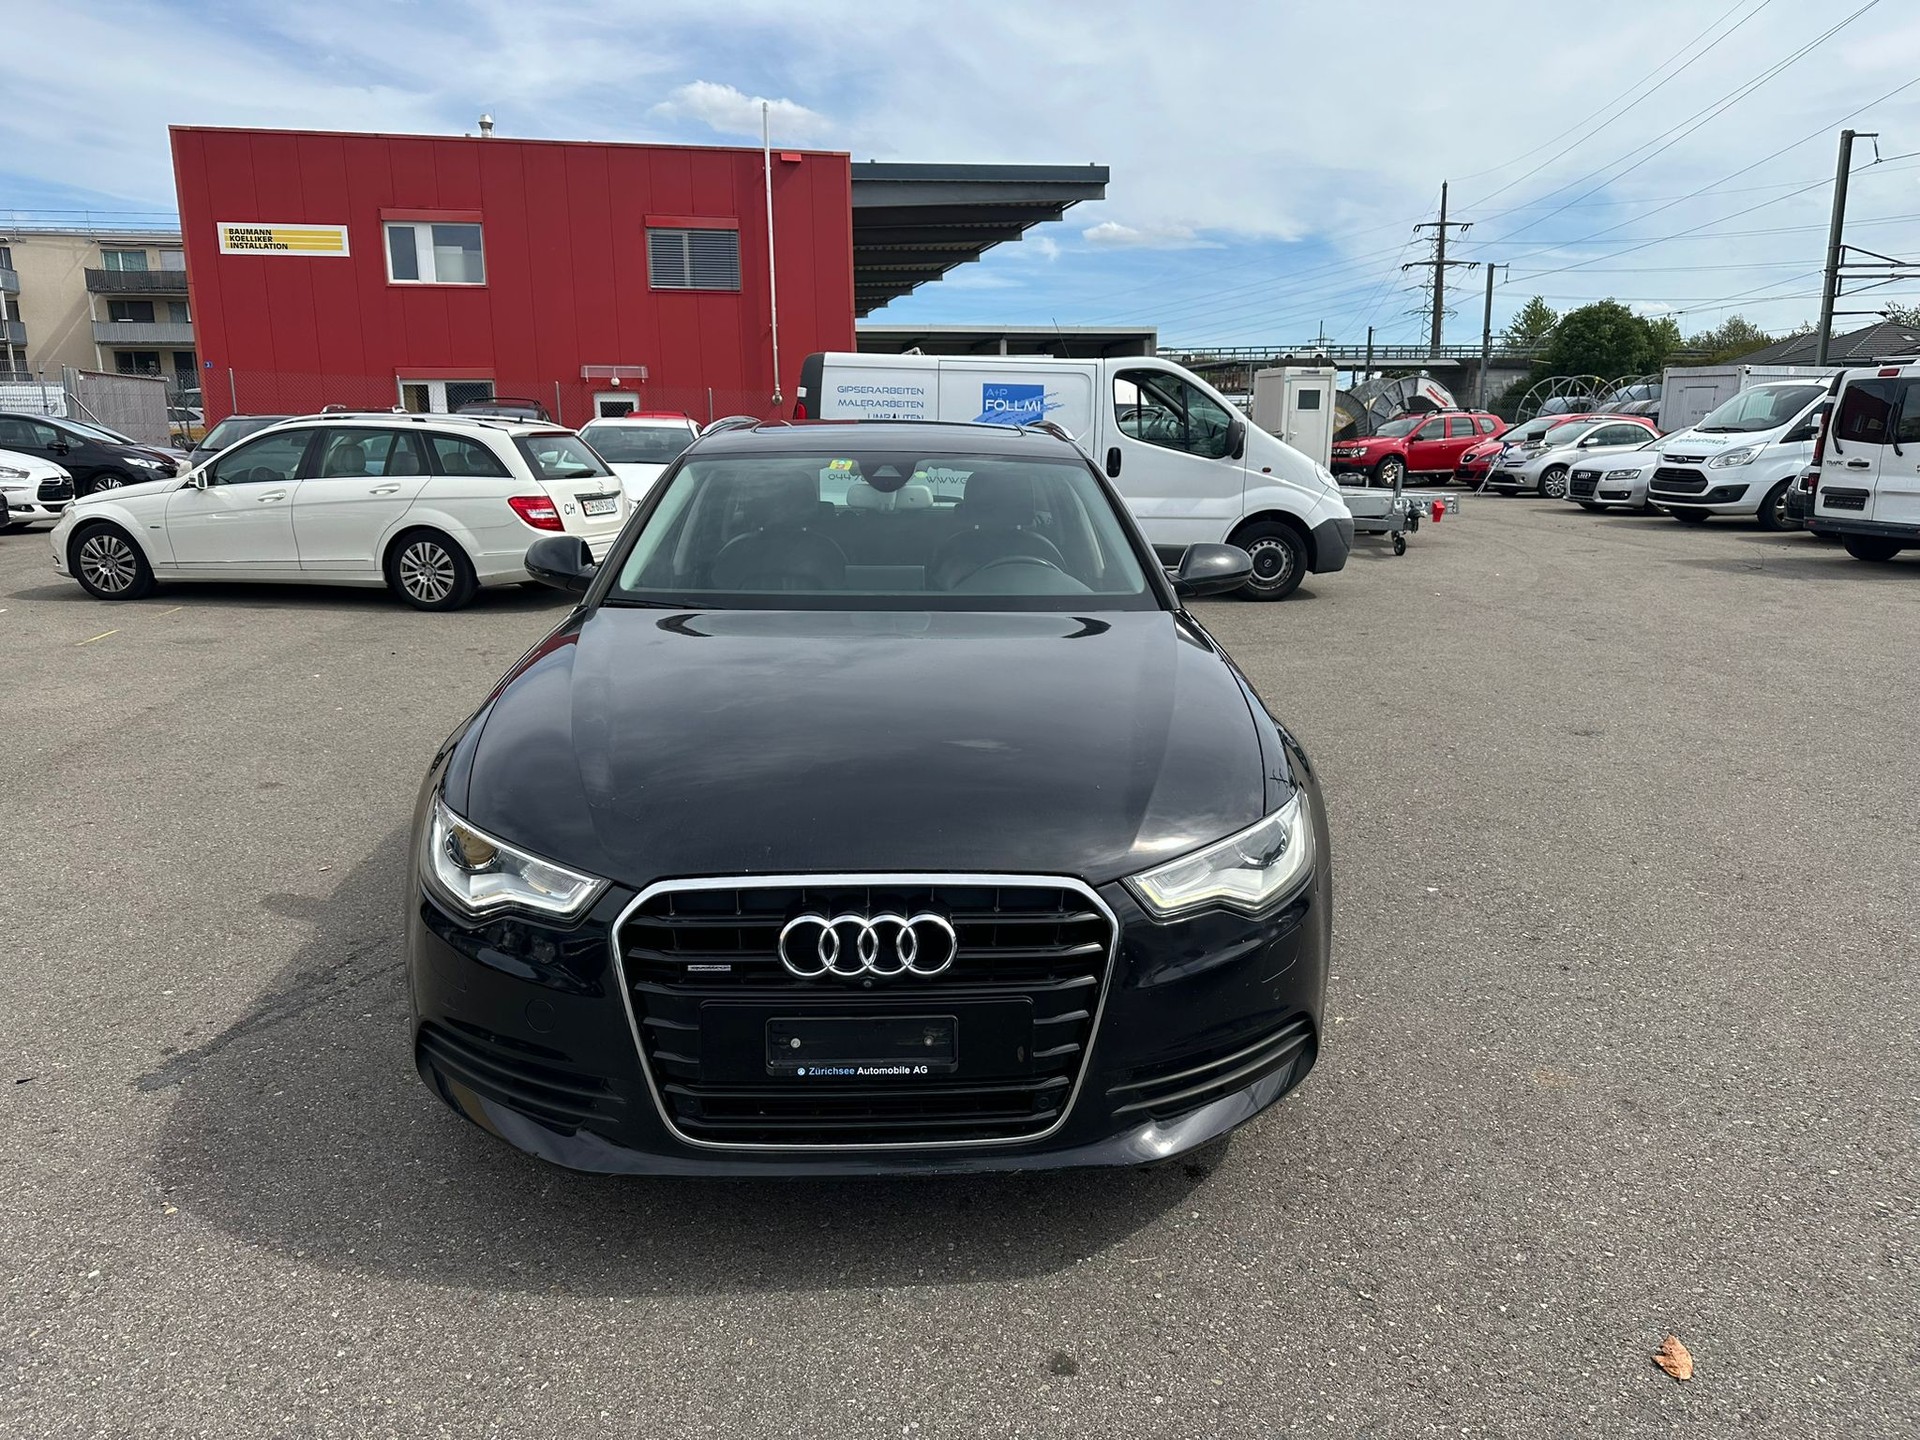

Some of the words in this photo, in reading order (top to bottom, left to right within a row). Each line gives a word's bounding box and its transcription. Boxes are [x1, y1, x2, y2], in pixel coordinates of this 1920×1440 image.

[228, 228, 272, 236] BAUMANN
[229, 235, 273, 243] KOELLIKER
[230, 242, 288, 250] INSTALLATION
[837, 385, 925, 396] GIPSERARBEITEN
[837, 399, 925, 409] MALERARBEITEN
[985, 396, 1041, 412] FÖLLMI
[563, 503, 576, 515] CH
[808, 1066, 855, 1076] Zürichsee
[856, 1066, 911, 1076] Automobile
[912, 1065, 928, 1075] AG
